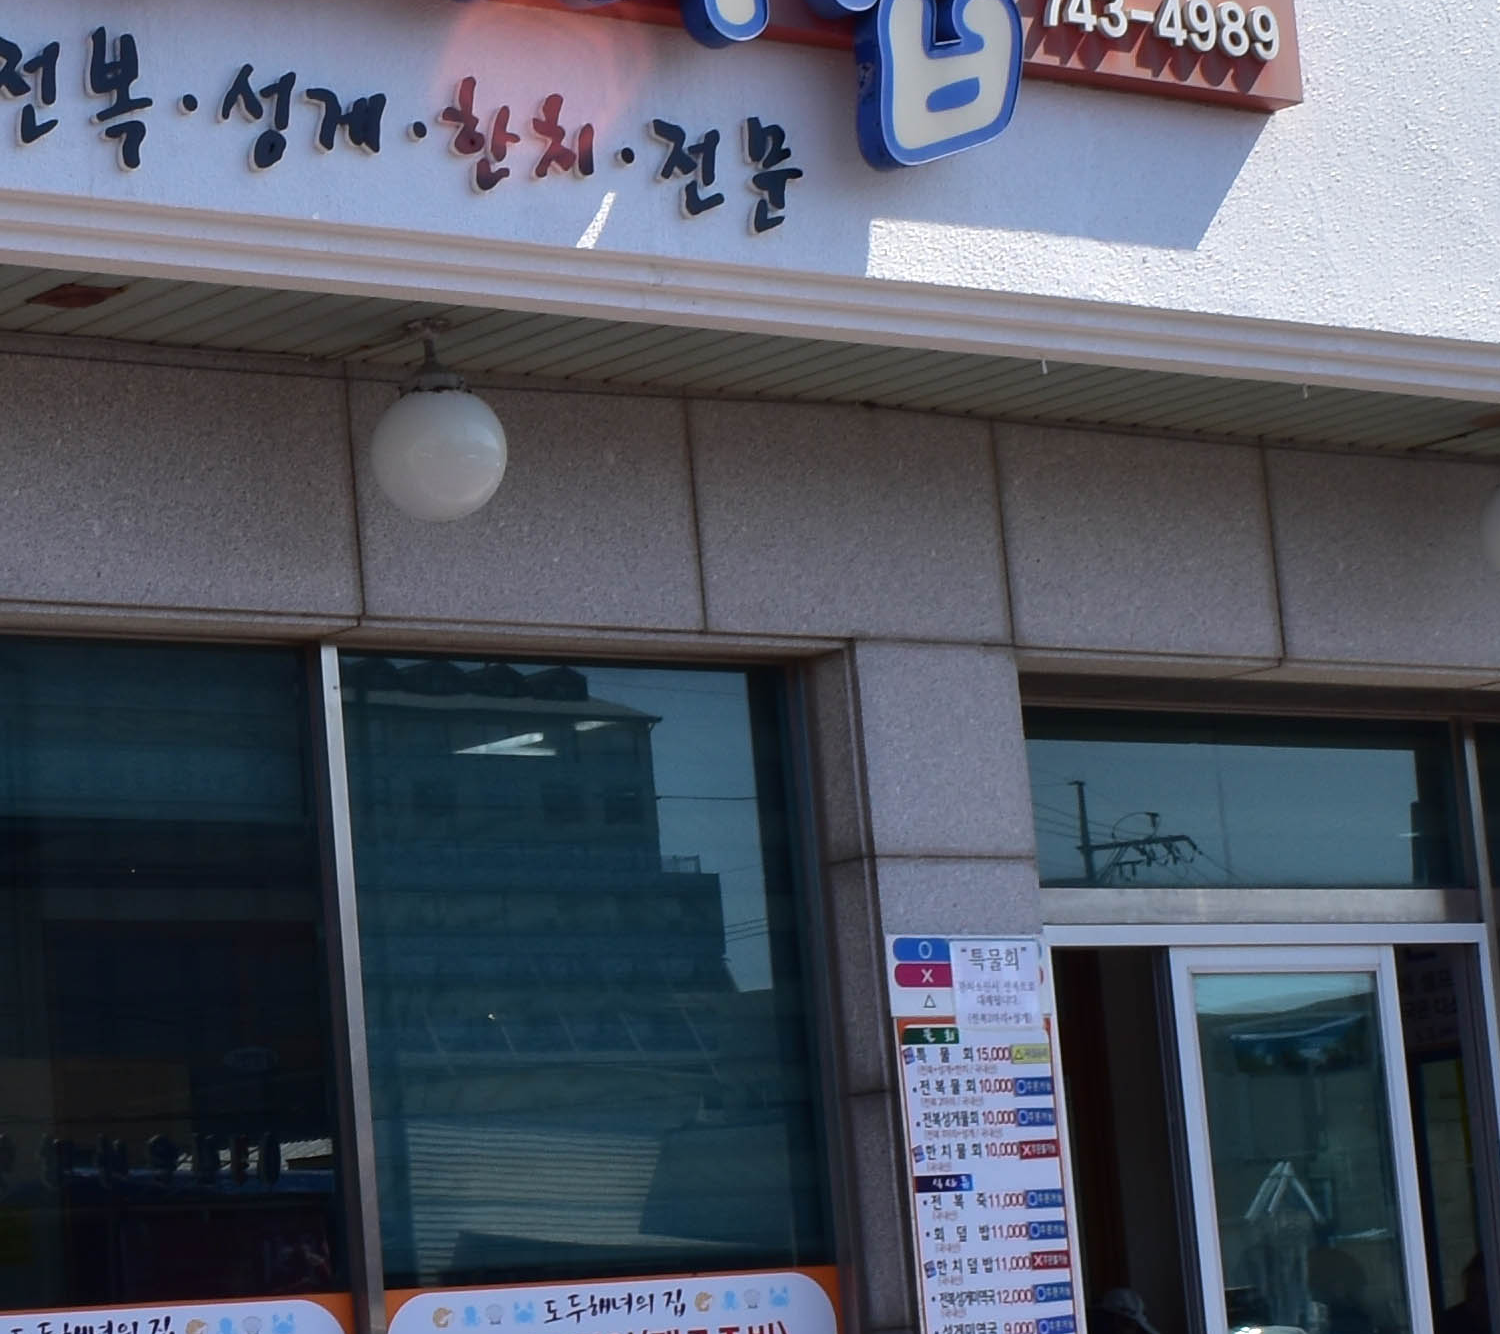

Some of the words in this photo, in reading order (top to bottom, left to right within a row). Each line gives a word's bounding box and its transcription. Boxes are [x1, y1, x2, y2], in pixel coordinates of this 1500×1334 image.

[977, 1047, 1010, 1063] 15,000
[980, 1079, 1013, 1094] 10,000
[982, 1111, 1016, 1126] 10,000
[985, 1143, 1019, 1158] 10,000
[989, 1193, 1024, 1208] 11,000
[992, 1224, 1028, 1240] 11,000
[994, 1256, 1031, 1271] 11,000
[997, 1289, 1033, 1304] 12,000
[544, 1292, 654, 1324] 도두해녀의
[664, 1288, 686, 1317] 집
